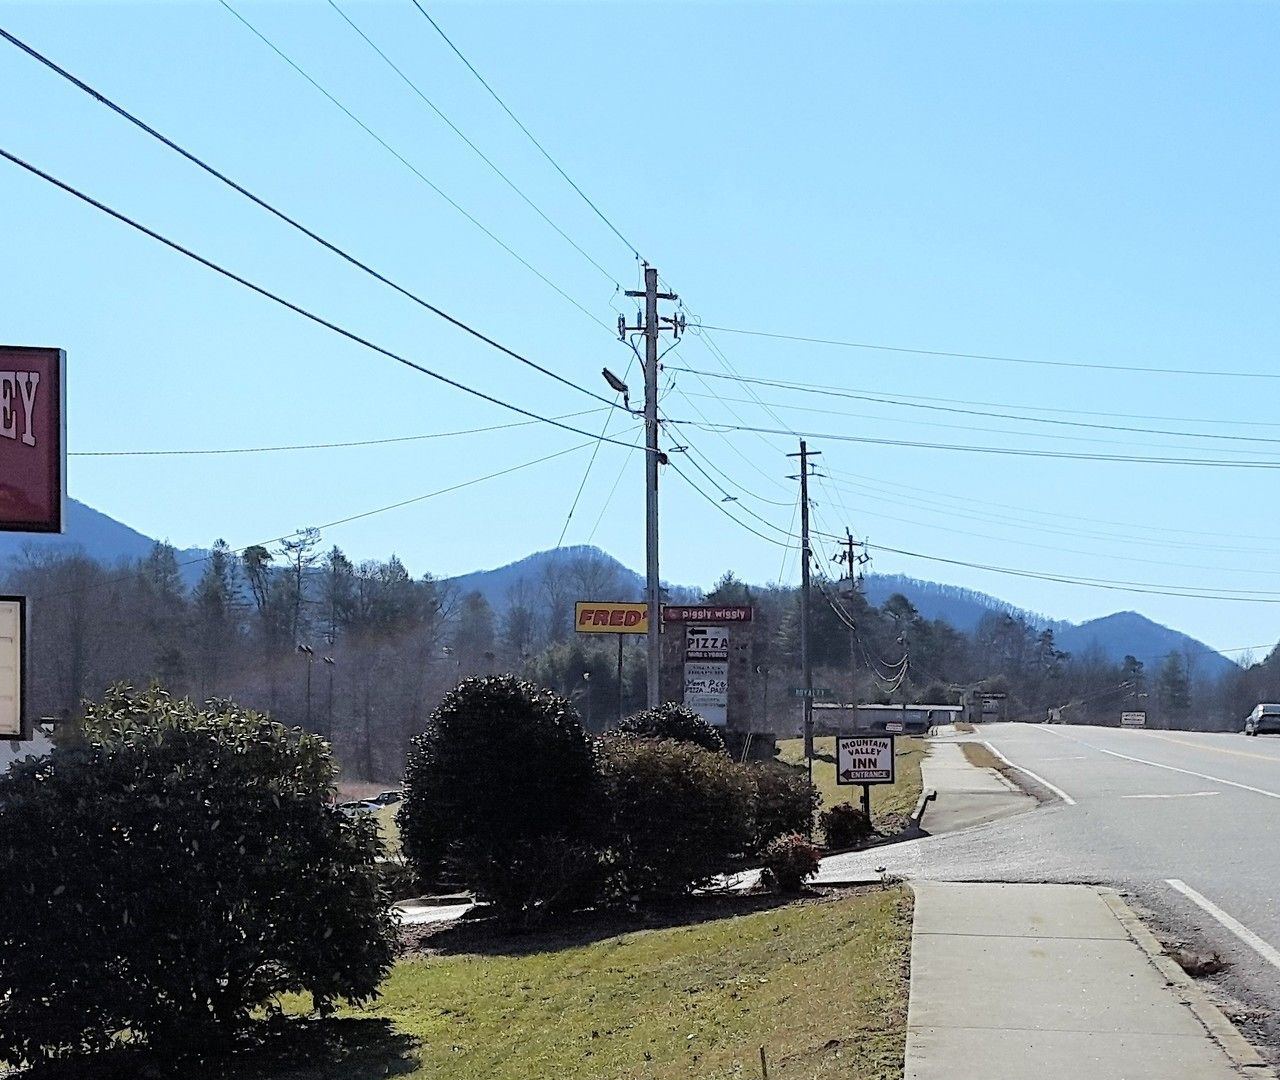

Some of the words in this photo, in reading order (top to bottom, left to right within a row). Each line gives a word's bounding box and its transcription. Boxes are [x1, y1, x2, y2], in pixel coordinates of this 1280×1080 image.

[579, 609, 649, 627] FRED'
[682, 611, 712, 619] piggly
[714, 611, 746, 620] wiggly
[688, 638, 728, 649] PIZZA
[841, 739, 888, 750] MOUNTAIN
[848, 747, 881, 756] VALLEY
[852, 757, 878, 769] INN
[851, 771, 888, 779] ENTRANCE
